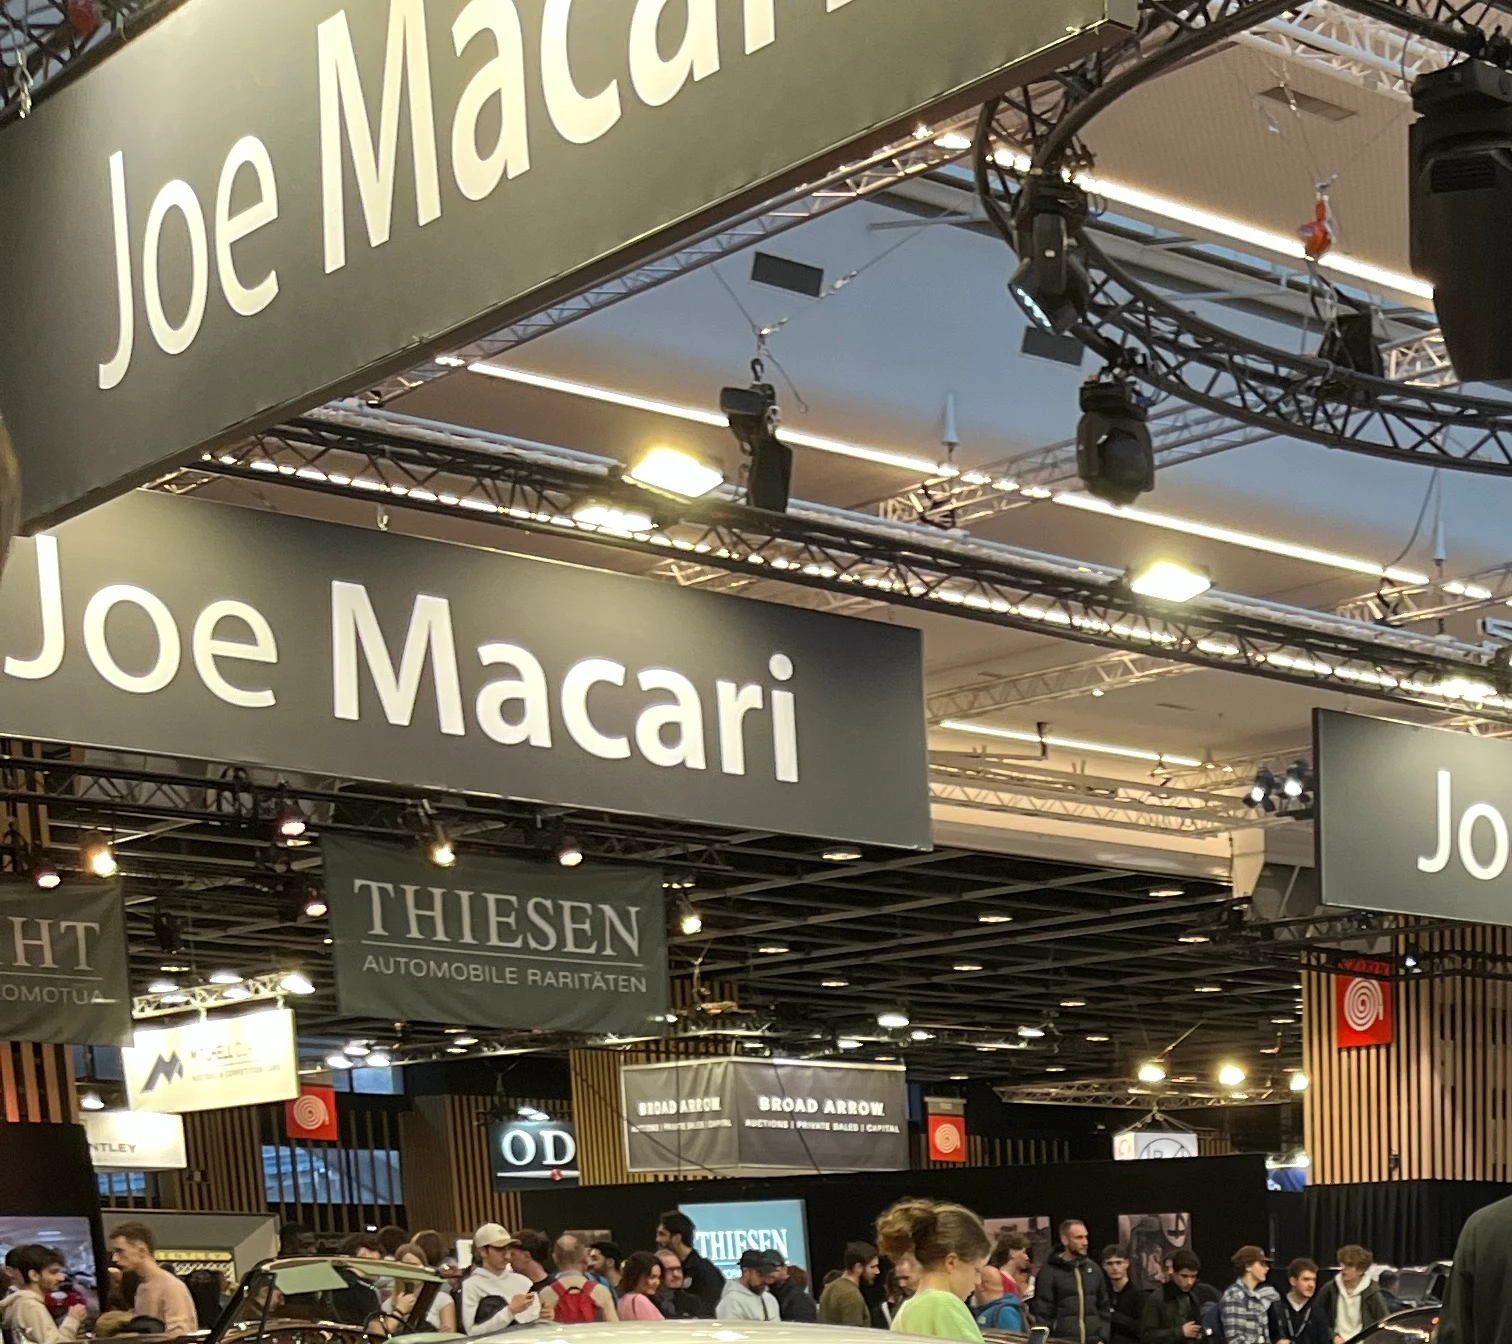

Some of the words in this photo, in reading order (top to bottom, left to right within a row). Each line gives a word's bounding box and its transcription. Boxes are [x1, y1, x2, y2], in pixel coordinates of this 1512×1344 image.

[99, 136, 280, 389] Joe
[317, 0, 853, 274] Maca
[4, 535, 279, 707] Joe
[330, 579, 799, 783] Macari
[354, 879, 640, 957] THIESEN
[363, 955, 519, 985] AUTOMOBILE
[527, 969, 647, 993] RARITÄTEN
[758, 1095, 818, 1113] BROAD
[745, 1119, 789, 1129] AUCTIONS
[796, 1120, 831, 1131] PRIVATE
[866, 1124, 900, 1133] CAPITAL
[88, 1143, 136, 1153] NTLEY
[502, 1129, 576, 1166] OD
[694, 1229, 788, 1260] THIESEN
